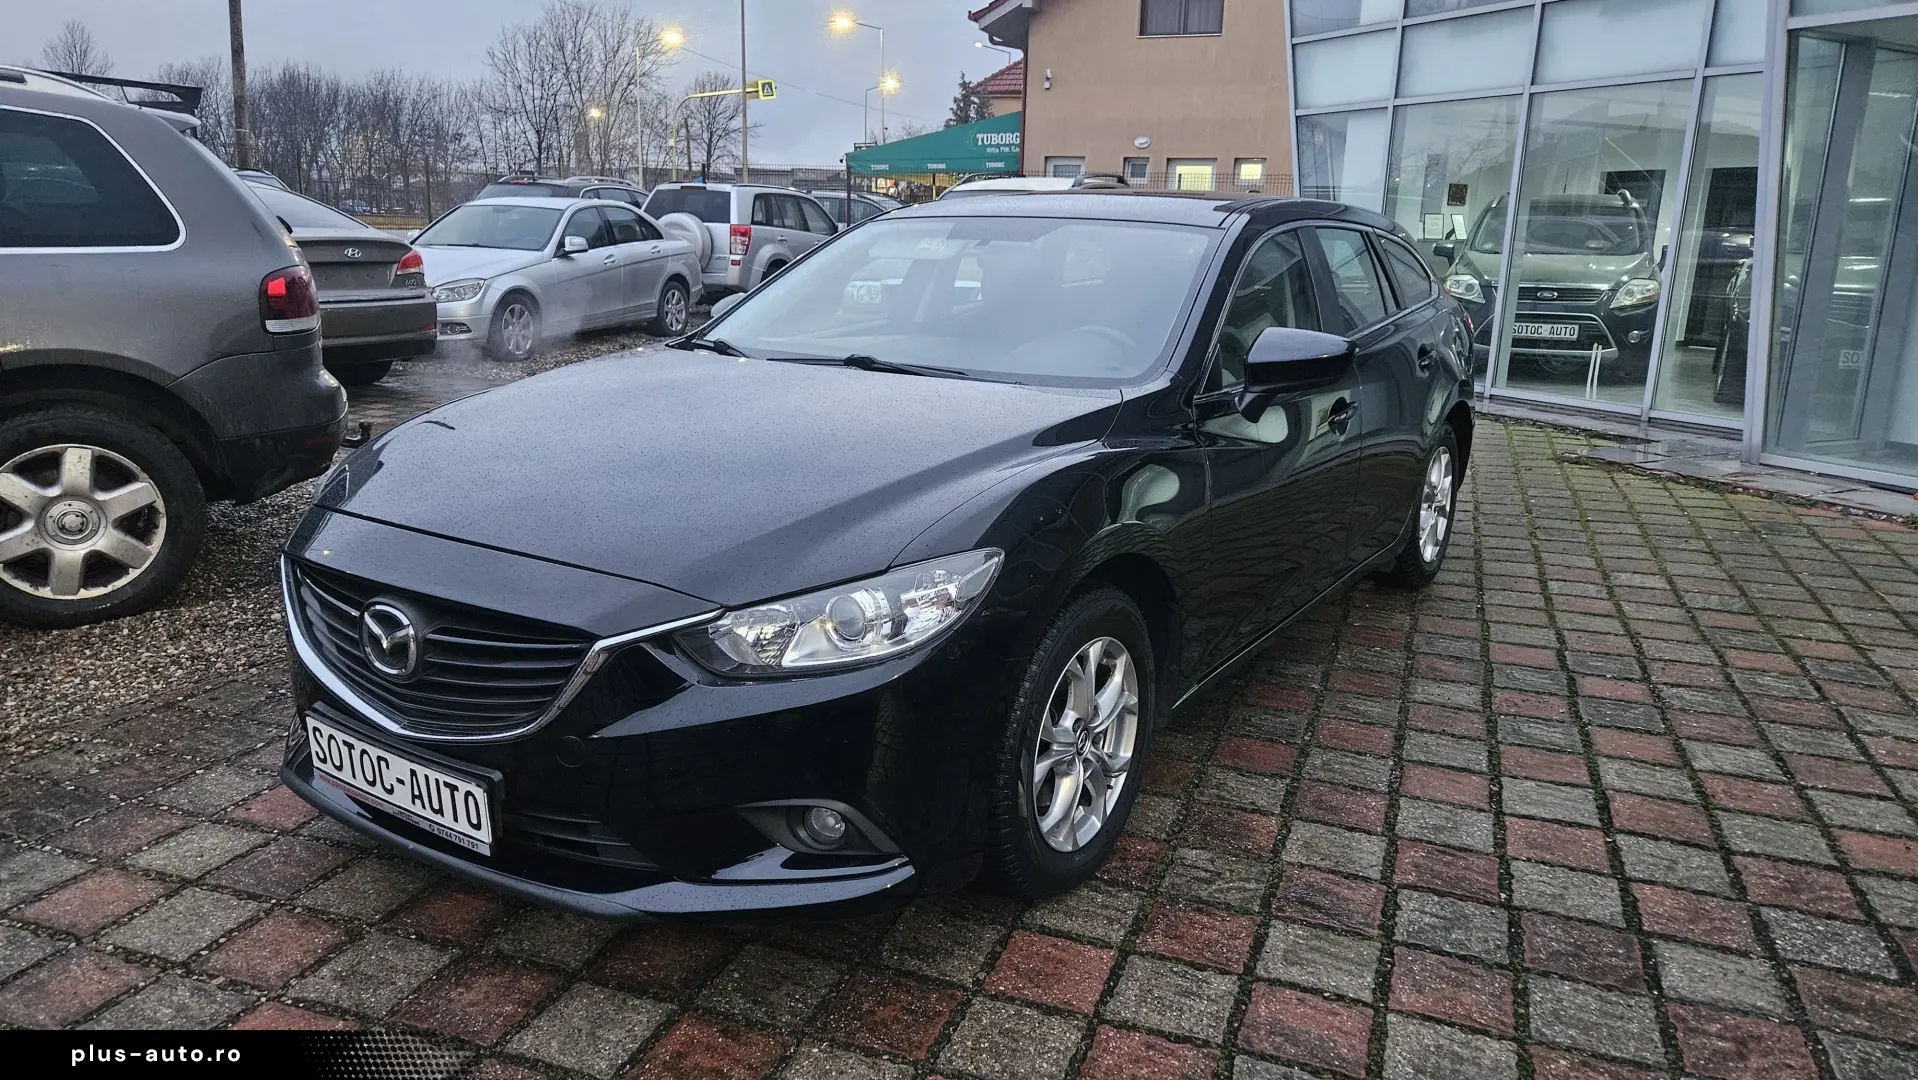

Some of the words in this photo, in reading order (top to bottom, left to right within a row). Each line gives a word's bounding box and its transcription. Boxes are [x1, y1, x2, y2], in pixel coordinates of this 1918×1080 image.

[976, 132, 1020, 146] TUBORG
[1512, 324, 1576, 337] SOTOC-AUTO
[1842, 351, 1864, 364] SO
[311, 725, 483, 832] SOTOC-AUTO
[467, 839, 479, 851] 791
